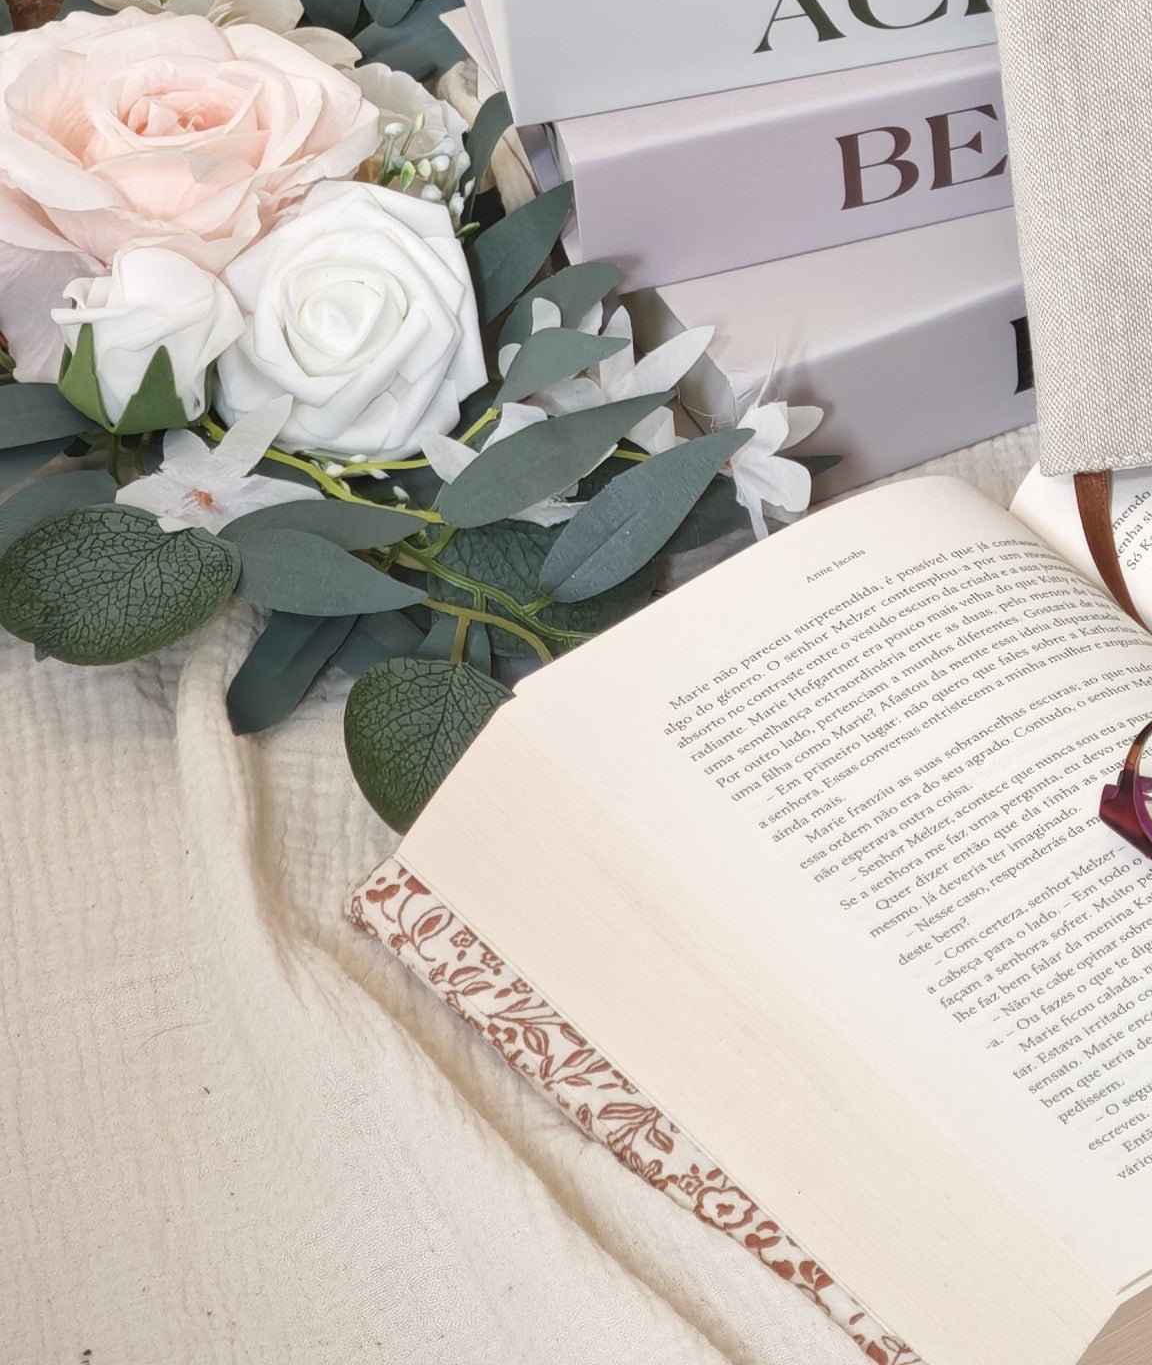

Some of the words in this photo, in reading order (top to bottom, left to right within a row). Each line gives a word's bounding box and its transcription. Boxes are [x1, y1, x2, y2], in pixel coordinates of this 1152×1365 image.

[805, 565, 834, 583] Anne
[831, 549, 866, 569] Jacobs
[667, 681, 711, 711] Marie
[711, 665, 739, 685] não
[739, 633, 792, 671] pareceu
[792, 584, 885, 636] surpreendida,
[894, 551, 949, 583] possível
[949, 545, 975, 560] que
[688, 725, 749, 763] radiante.
[745, 698, 789, 727] Marie
[785, 654, 860, 702] Hofgartner
[861, 642, 884, 658] era
[883, 619, 926, 648] pouco
[925, 603, 959, 623] mais
[714, 769, 741, 789] Por
[742, 747, 781, 773] outro
[778, 727, 816, 750] lado,
[814, 681, 890, 731] pertenciam
[900, 643, 956, 678] mundos
[955, 615, 1023, 647] diferentes.
[800, 740, 861, 782] primeiro
[858, 716, 902, 744] lugar:
[901, 699, 929, 719] não
[930, 676, 970, 702] quero
[971, 662, 997, 680] que
[996, 647, 1030, 666] fales
[1030, 634, 1068, 653] sobre
[802, 815, 847, 844] Marie
[845, 784, 896, 818] franziu
[912, 755, 943, 778] suas
[943, 706, 1027, 759] sobrancelhas
[1027, 682, 1082, 711] escuras;
[812, 863, 840, 884] não
[840, 827, 899, 867] esperava
[897, 805, 936, 831] outra
[935, 783, 974, 808] coisa.
[868, 904, 923, 939] mesmo.
[937, 861, 988, 896] deveria
[985, 848, 1007, 865] ter
[1005, 806, 1082, 853] imaginado.
[897, 940, 934, 966] deste
[929, 914, 970, 944] bem?
[950, 1005, 978, 1024] lhe
[976, 991, 1001, 1009] faz
[996, 972, 1033, 995] bem
[1029, 949, 1062, 975] falar
[1082, 907, 1135, 943] menina
[1011, 1062, 1038, 1080] tar.
[1033, 1033, 1083, 1064] Estava
[1080, 999, 1136, 1037] irritado
[1016, 1023, 1062, 1053] Marie
[1058, 1001, 1097, 1028] ficou
[1095, 974, 1145, 1005] calada,
[1055, 1079, 1126, 1126] pedissem.
[1087, 1111, 1150, 1151] escreveu.
